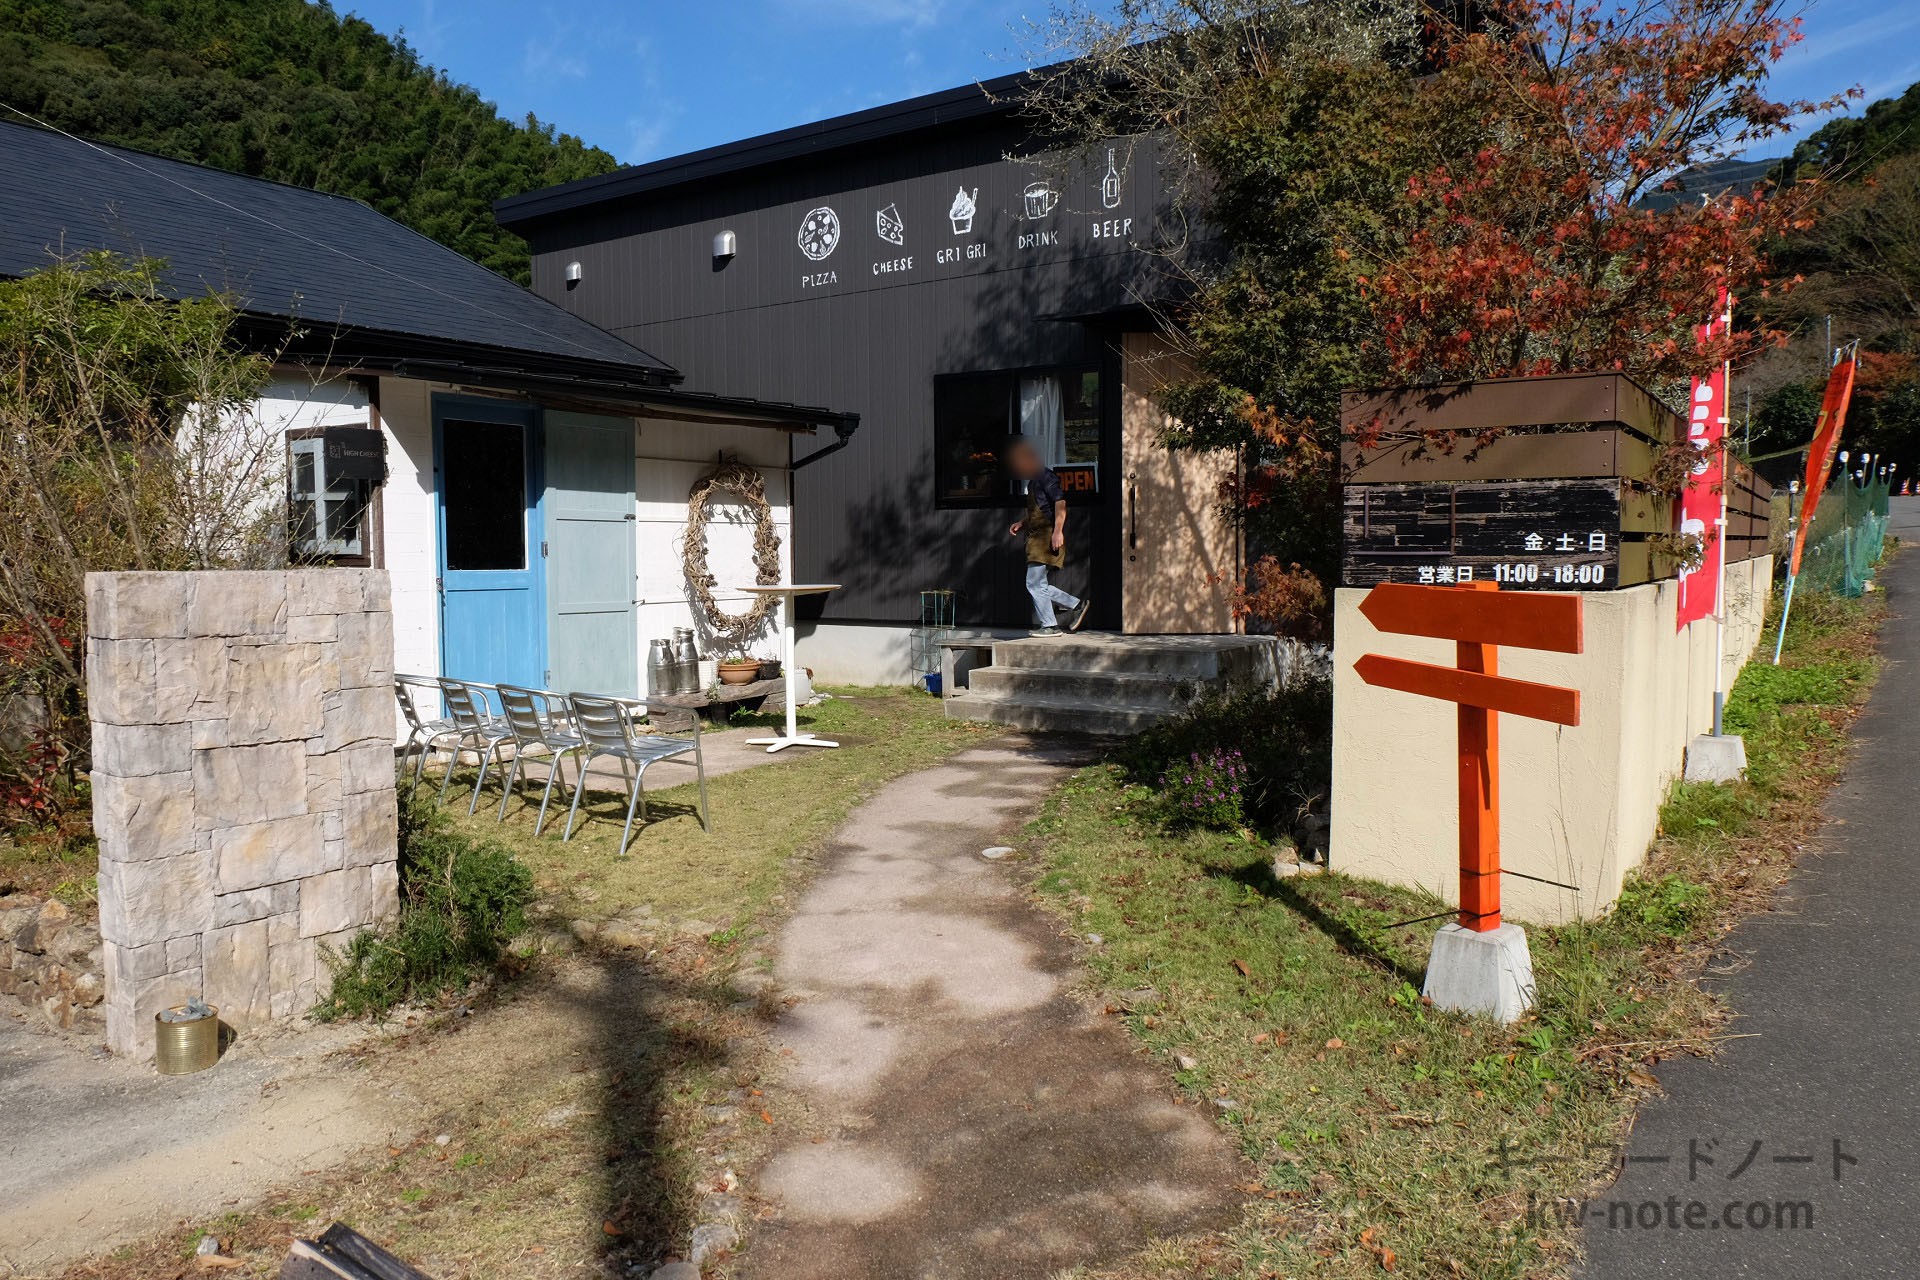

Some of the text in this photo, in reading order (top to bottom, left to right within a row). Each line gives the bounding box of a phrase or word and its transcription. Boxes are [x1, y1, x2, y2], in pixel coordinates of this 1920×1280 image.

[1092, 218, 1134, 239] BEER
[1018, 231, 1059, 249] DRINK
[872, 257, 914, 275] CHEESE
[802, 271, 837, 288] PIZZA
[1418, 565, 1473, 583] 営業日
[1492, 564, 1539, 582] 11:00
[1554, 564, 1605, 584] 18:00
